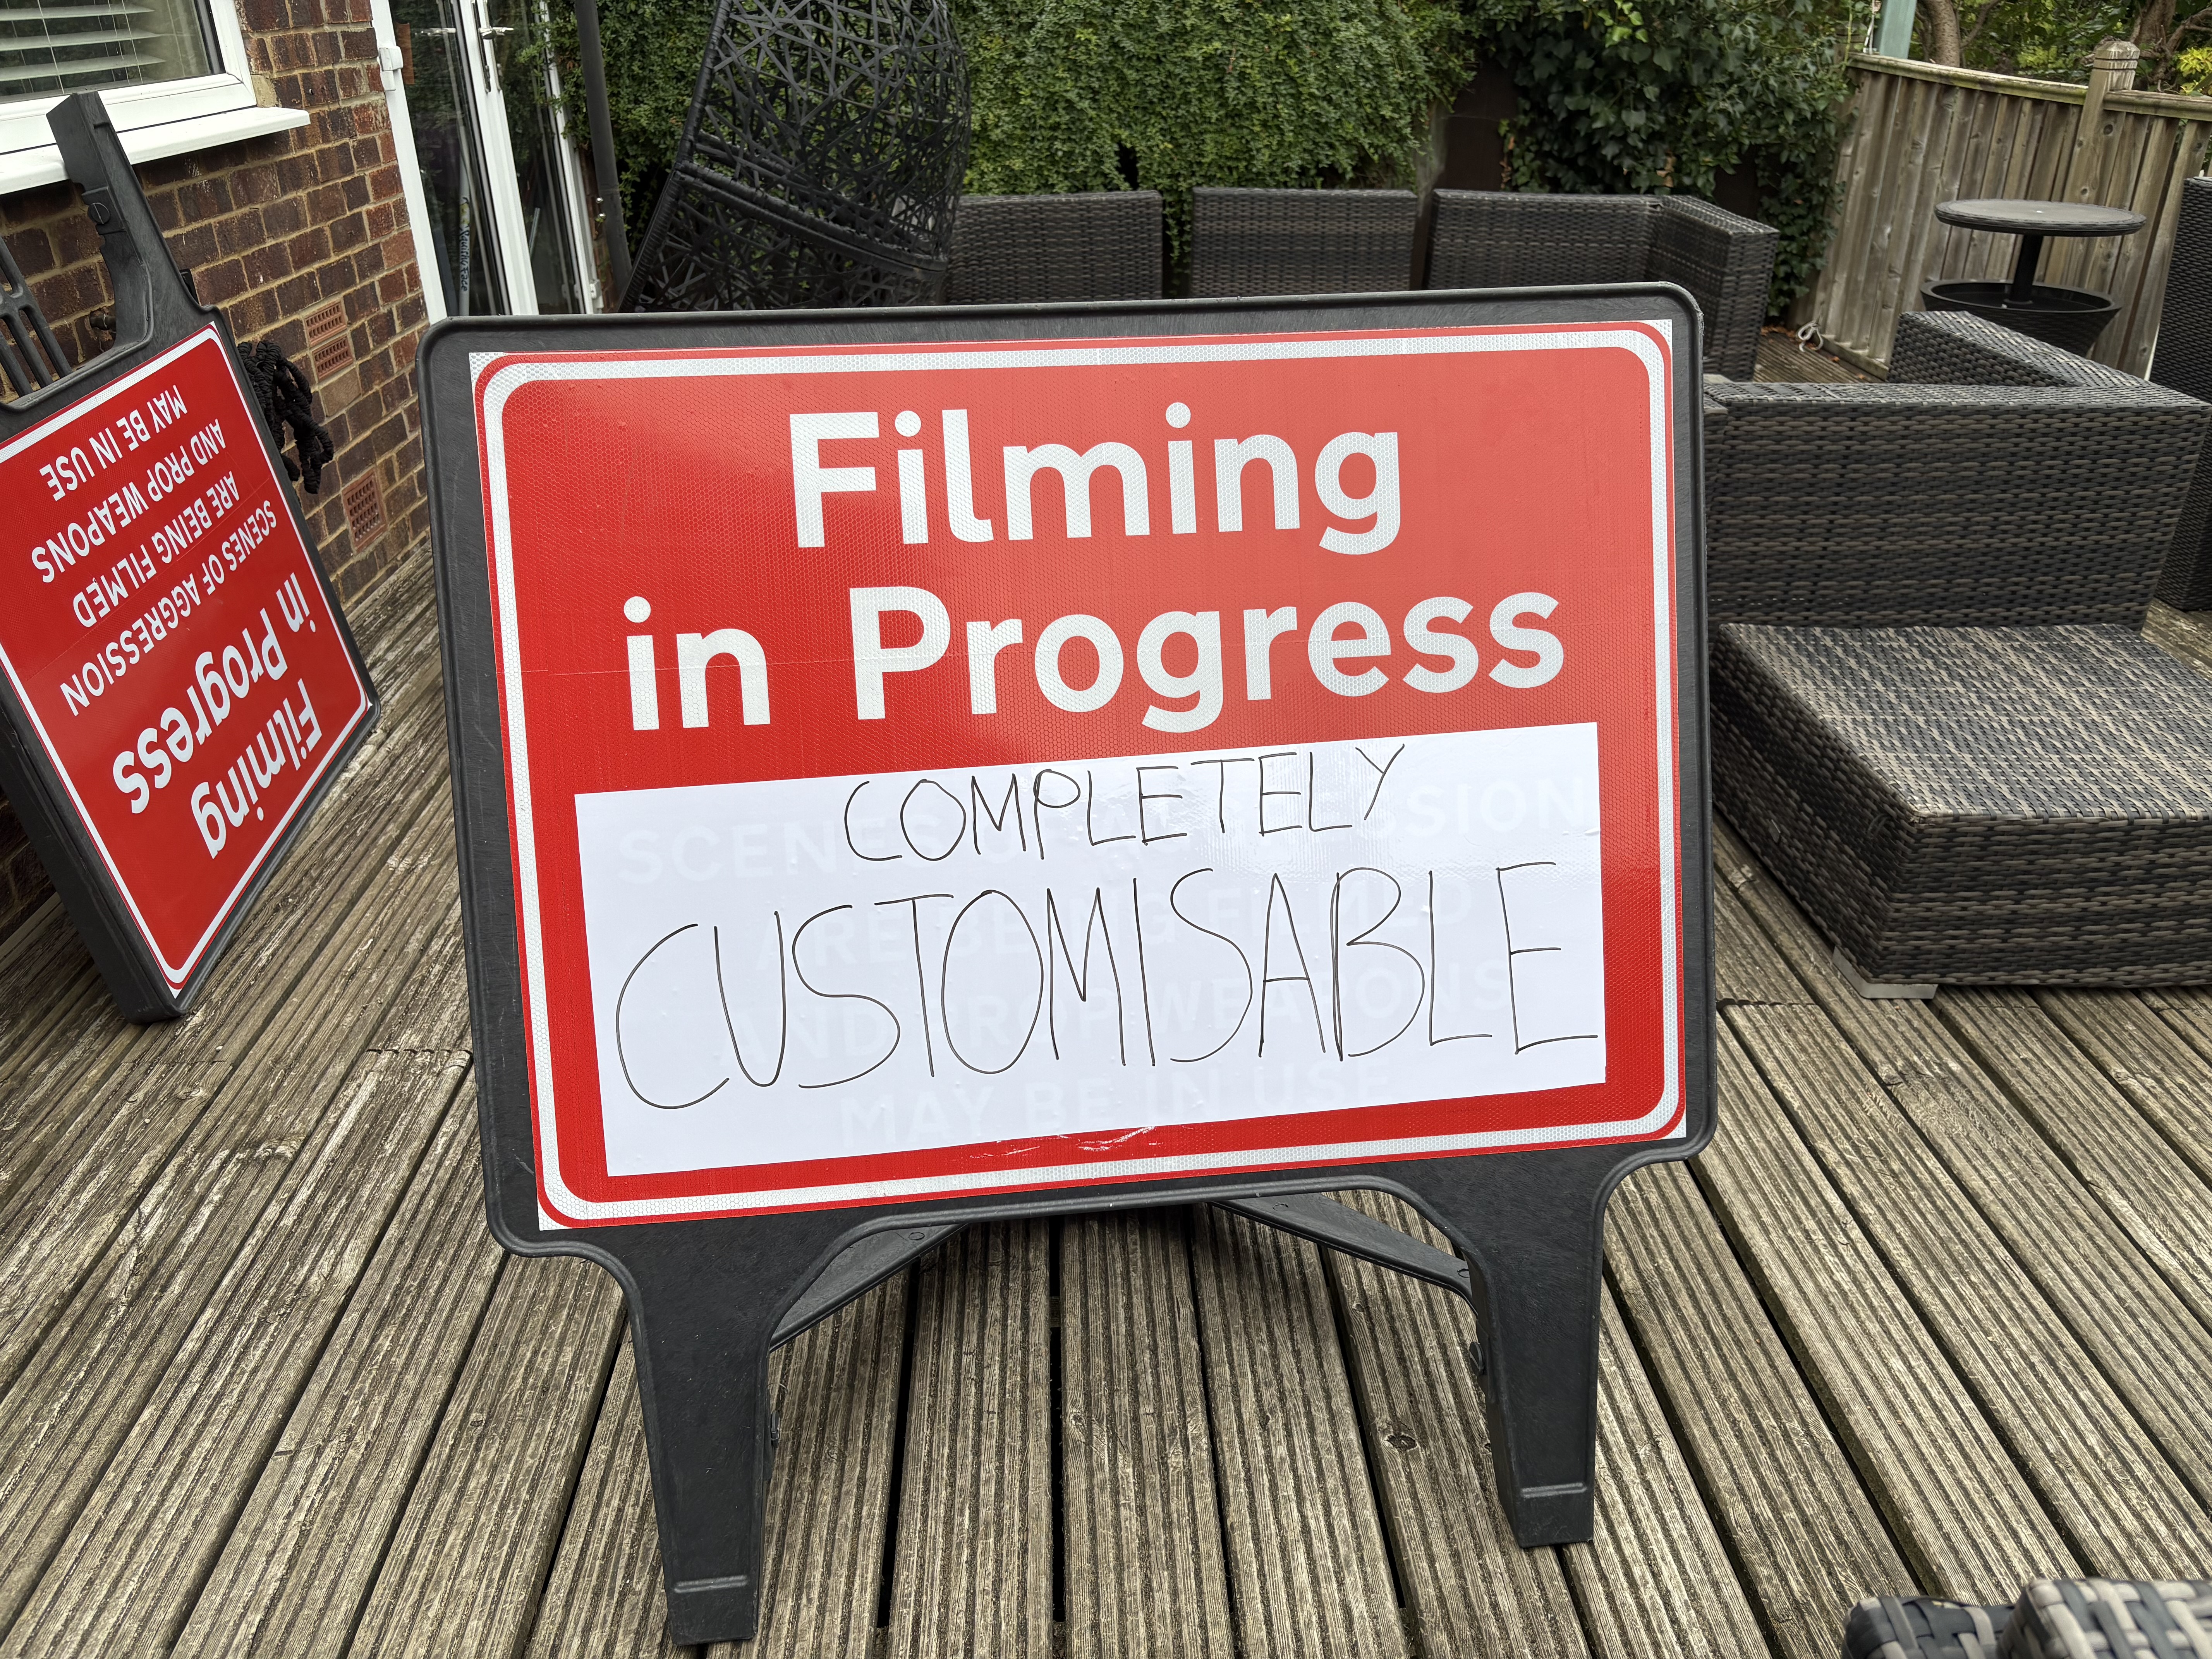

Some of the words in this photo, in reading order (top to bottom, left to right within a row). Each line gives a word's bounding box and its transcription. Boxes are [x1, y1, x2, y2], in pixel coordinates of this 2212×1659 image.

[116, 409, 151, 451] BE
[147, 385, 188, 433] MAY
[190, 418, 226, 465] AND
[40, 447, 95, 501] USE
[89, 427, 123, 469] IN
[147, 445, 195, 502] PROP
[790, 402, 1401, 555] Filming
[206, 471, 239, 518] ARE
[32, 481, 149, 583] WEAPONS
[151, 498, 213, 563] BEING
[222, 500, 276, 571] SCENES
[73, 544, 156, 627] FILMED
[202, 555, 225, 595] OF
[276, 572, 317, 633] in
[60, 573, 201, 716] AGGRESSION
[624, 596, 770, 730] in
[850, 586, 1564, 733] Progress
[113, 608, 287, 813] Progress
[191, 678, 322, 859] Filming
[844, 744, 1405, 861] COMPLETELY
[616, 862, 1599, 1109] CUSTOMISABLE
